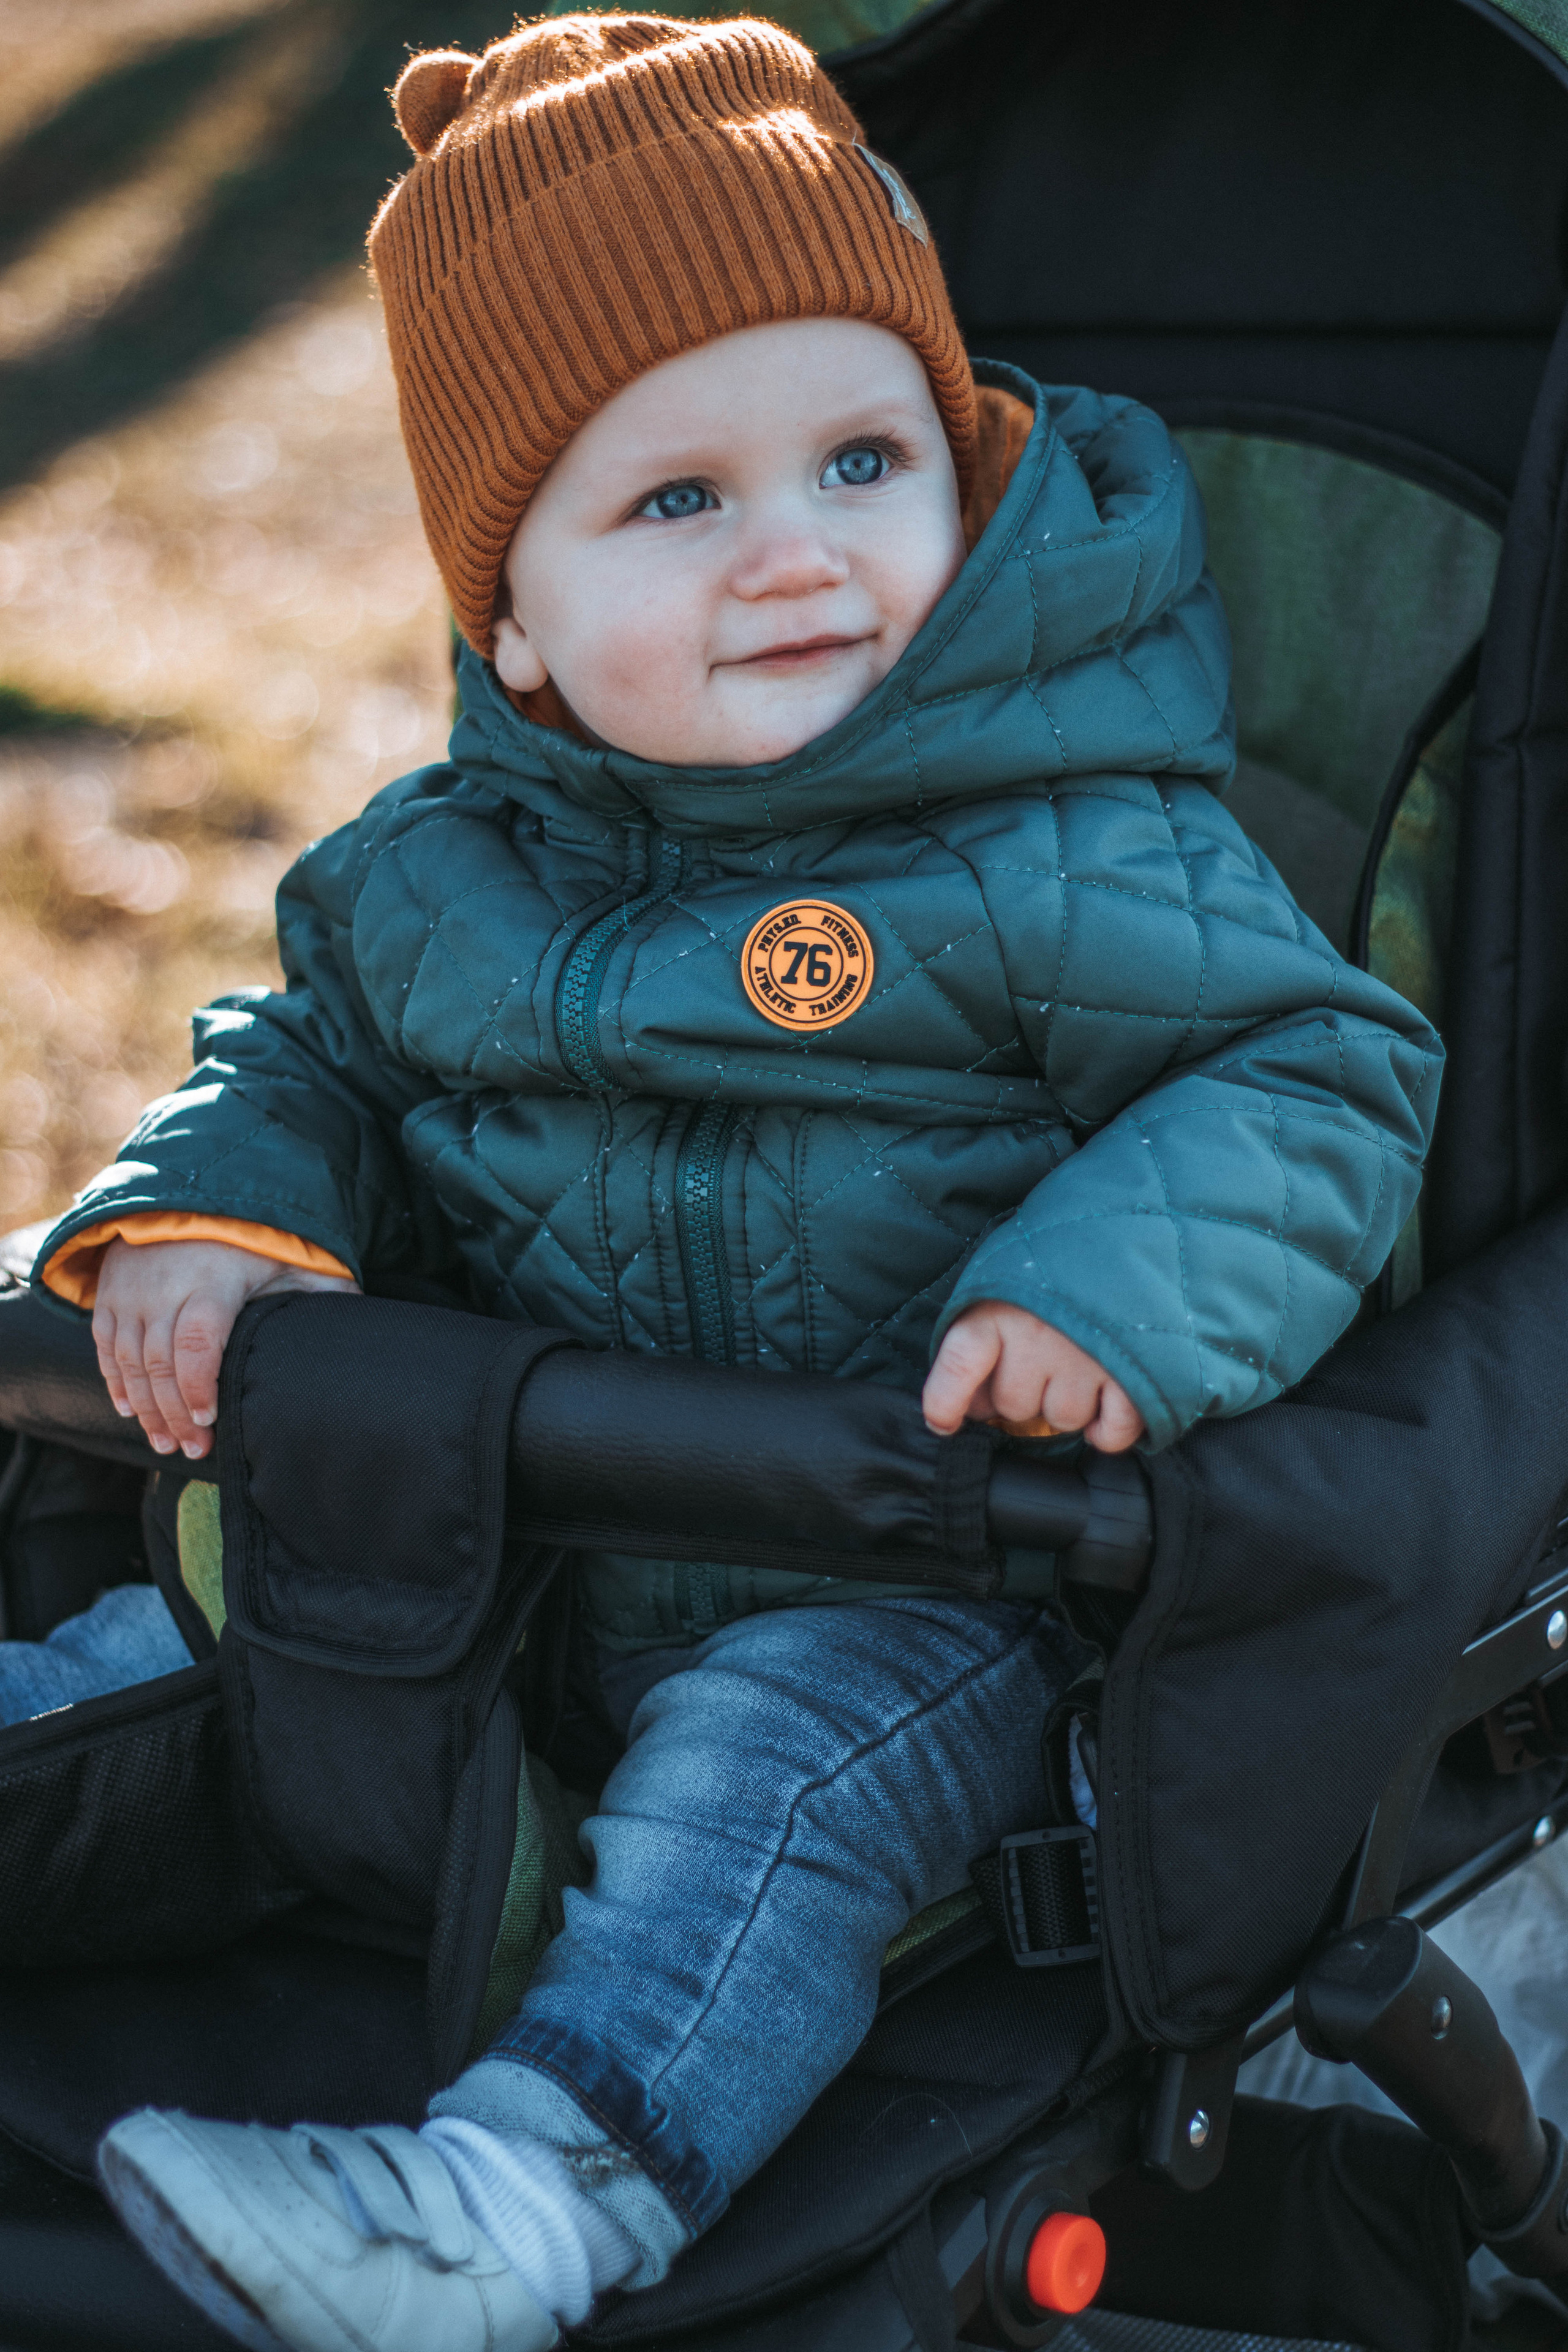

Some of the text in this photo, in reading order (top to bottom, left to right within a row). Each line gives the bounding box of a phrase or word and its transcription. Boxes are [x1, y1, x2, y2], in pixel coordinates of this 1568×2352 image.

[821, 915, 859, 958] FITNESS
[780, 941, 833, 987] 76
[755, 966, 858, 1016] ATHLETIC TRAINING
